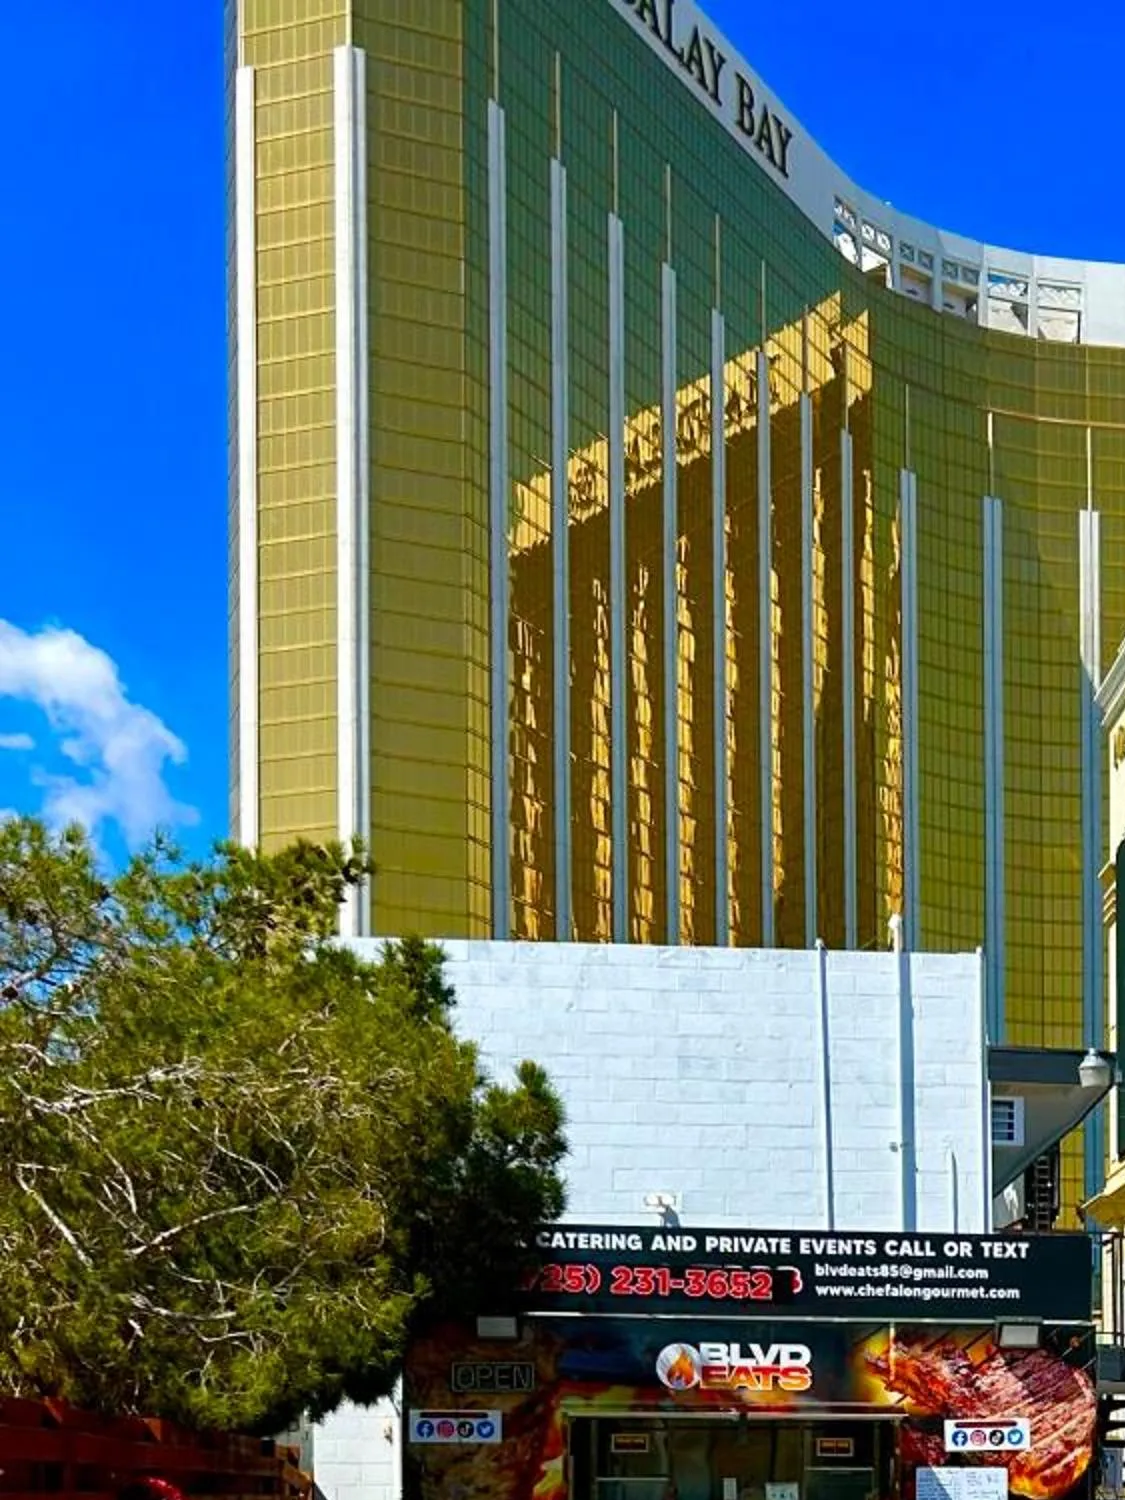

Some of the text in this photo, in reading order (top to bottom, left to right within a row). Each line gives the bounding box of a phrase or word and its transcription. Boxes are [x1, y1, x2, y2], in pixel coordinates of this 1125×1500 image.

[734, 71, 793, 179] BAY
[535, 1231, 643, 1251] CATERING
[651, 1234, 697, 1251] AND
[705, 1236, 792, 1255] PRIVATE
[799, 1237, 877, 1256] EVENTS
[883, 1240, 937, 1258] CALL
[943, 1241, 974, 1258] OR
[980, 1242, 1030, 1259] TEXT
[608, 1265, 773, 1300] 231-3652
[814, 1263, 989, 1281] blvdeats85@gmail.com
[814, 1283, 1021, 1300] www.chefalongourmet.com
[698, 1342, 812, 1369] BLVD
[455, 1364, 532, 1390] OPEN
[700, 1365, 813, 1391] EATS
